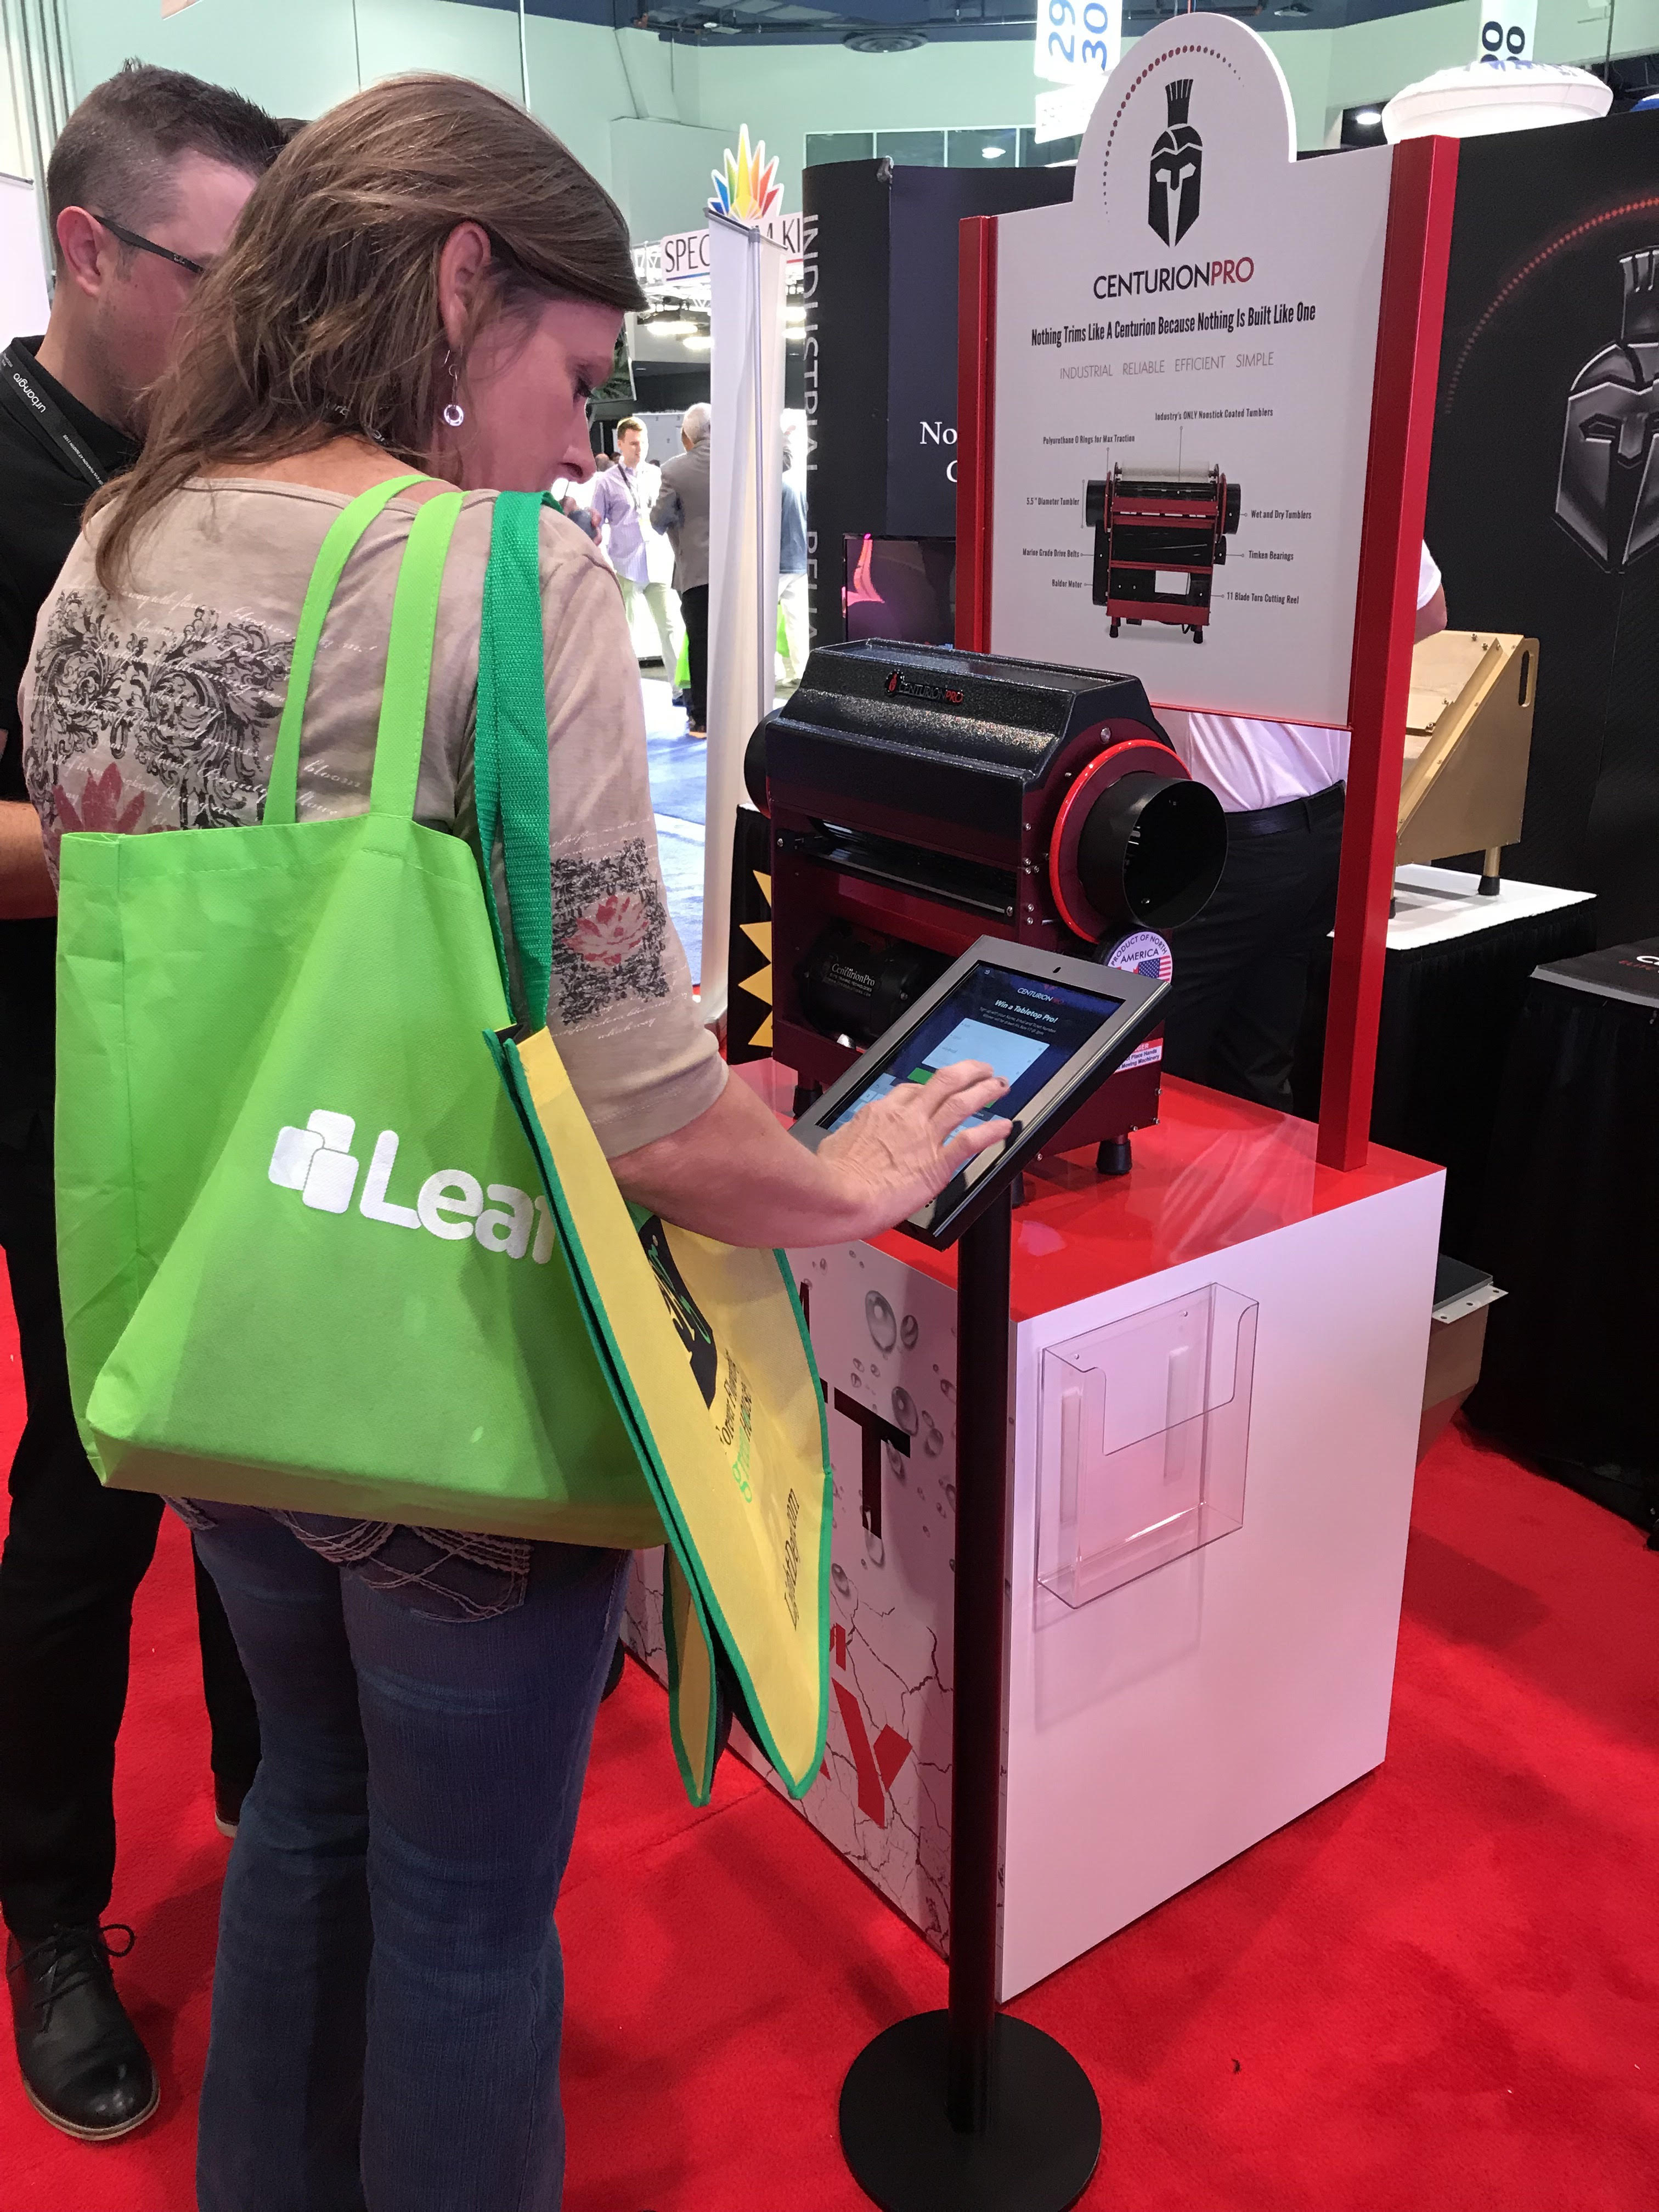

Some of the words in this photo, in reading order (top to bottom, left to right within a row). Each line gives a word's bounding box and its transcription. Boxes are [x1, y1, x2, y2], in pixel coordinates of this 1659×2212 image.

[1093, 256, 1255, 300] CENTURIONPRO
[1031, 328, 1062, 348] Nothing
[1063, 325, 1086, 343] Trims
[1088, 323, 1105, 341] Like
[1107, 321, 1113, 340] A
[1114, 318, 1156, 339] Centurion
[1158, 316, 1195, 334] Because
[1197, 310, 1234, 333] Nothing
[1236, 308, 1245, 328] Is
[1248, 306, 1271, 326] Built
[1273, 303, 1294, 324] Like
[1296, 301, 1316, 322] One
[1059, 364, 1113, 380] INDUSTRIAL
[1122, 360, 1165, 375] RELIABLE
[1175, 355, 1226, 372] EFFICIENT
[1235, 351, 1274, 368] SIMPLE
[1155, 412, 1182, 421] Industry's
[1183, 410, 1198, 420] ONLY
[1199, 409, 1223, 419] Nonstick
[1224, 408, 1245, 418] Coated
[1246, 407, 1273, 417] Tumblers
[1103, 435, 1113, 443] Max
[1114, 434, 1136, 443] Traction
[1060, 497, 1080, 505] Tumbler
[1251, 510, 1262, 518] Wet
[1263, 510, 1273, 518] and
[1274, 510, 1284, 520] Dry
[1285, 510, 1312, 519] Tumblers
[1023, 548, 1038, 556] Marine
[1248, 550, 1268, 559] Timken
[1269, 551, 1294, 561] Bearings
[1227, 592, 1233, 600] 11
[1235, 592, 1250, 601] Blade
[1265, 594, 1285, 605] Cutting
[1286, 595, 1299, 604] Reel
[1111, 935, 1139, 966] PRODUCT
[1150, 935, 1168, 955] NORTH
[1120, 948, 1160, 964] AMERICA
[994, 1000, 1008, 1008] Win
[1014, 1005, 1042, 1019] Tabletop
[1042, 1014, 1059, 1024] Pro!
[1138, 1054, 1160, 1064] Machinery
